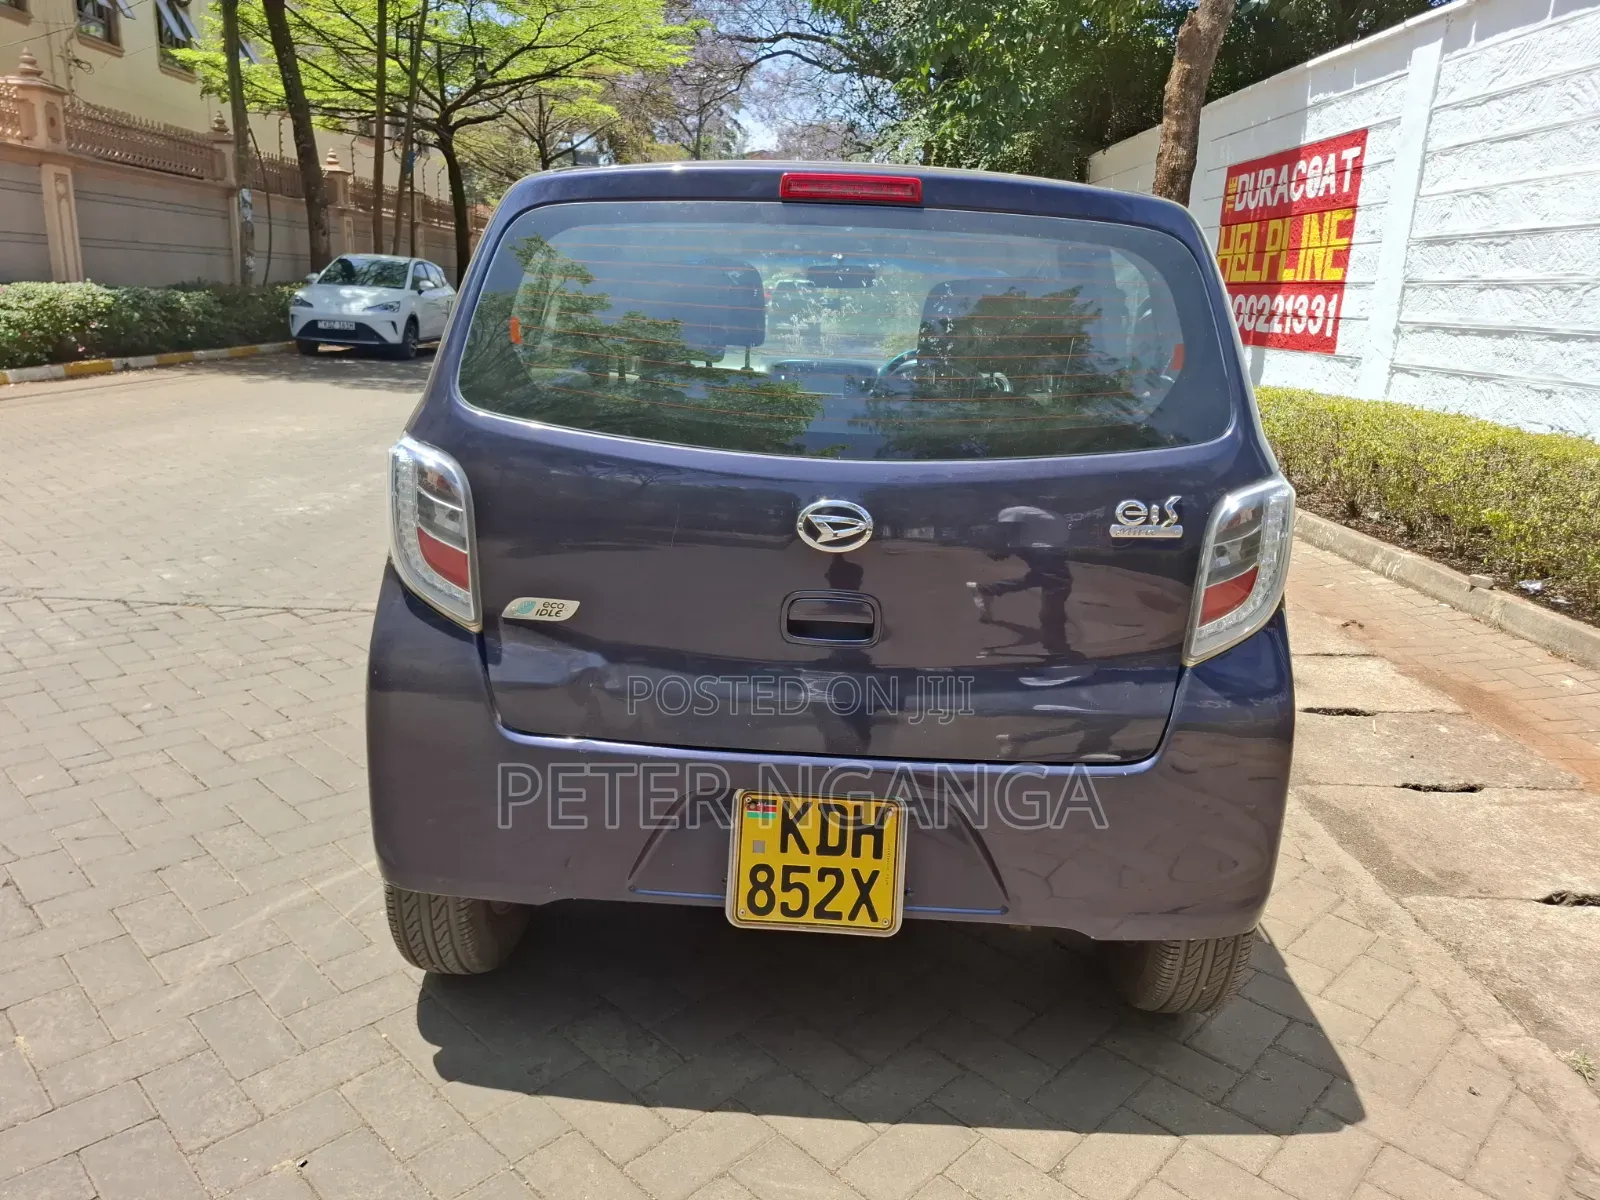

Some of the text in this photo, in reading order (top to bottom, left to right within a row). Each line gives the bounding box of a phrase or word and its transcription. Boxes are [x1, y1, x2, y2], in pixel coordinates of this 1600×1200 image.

[1234, 147, 1361, 212] DURACOAT
[1217, 208, 1354, 282] HELPLINE
[535, 609, 563, 618] IDLE
[542, 602, 565, 610] eco
[779, 800, 886, 860] KDH
[746, 863, 880, 922] 852X
